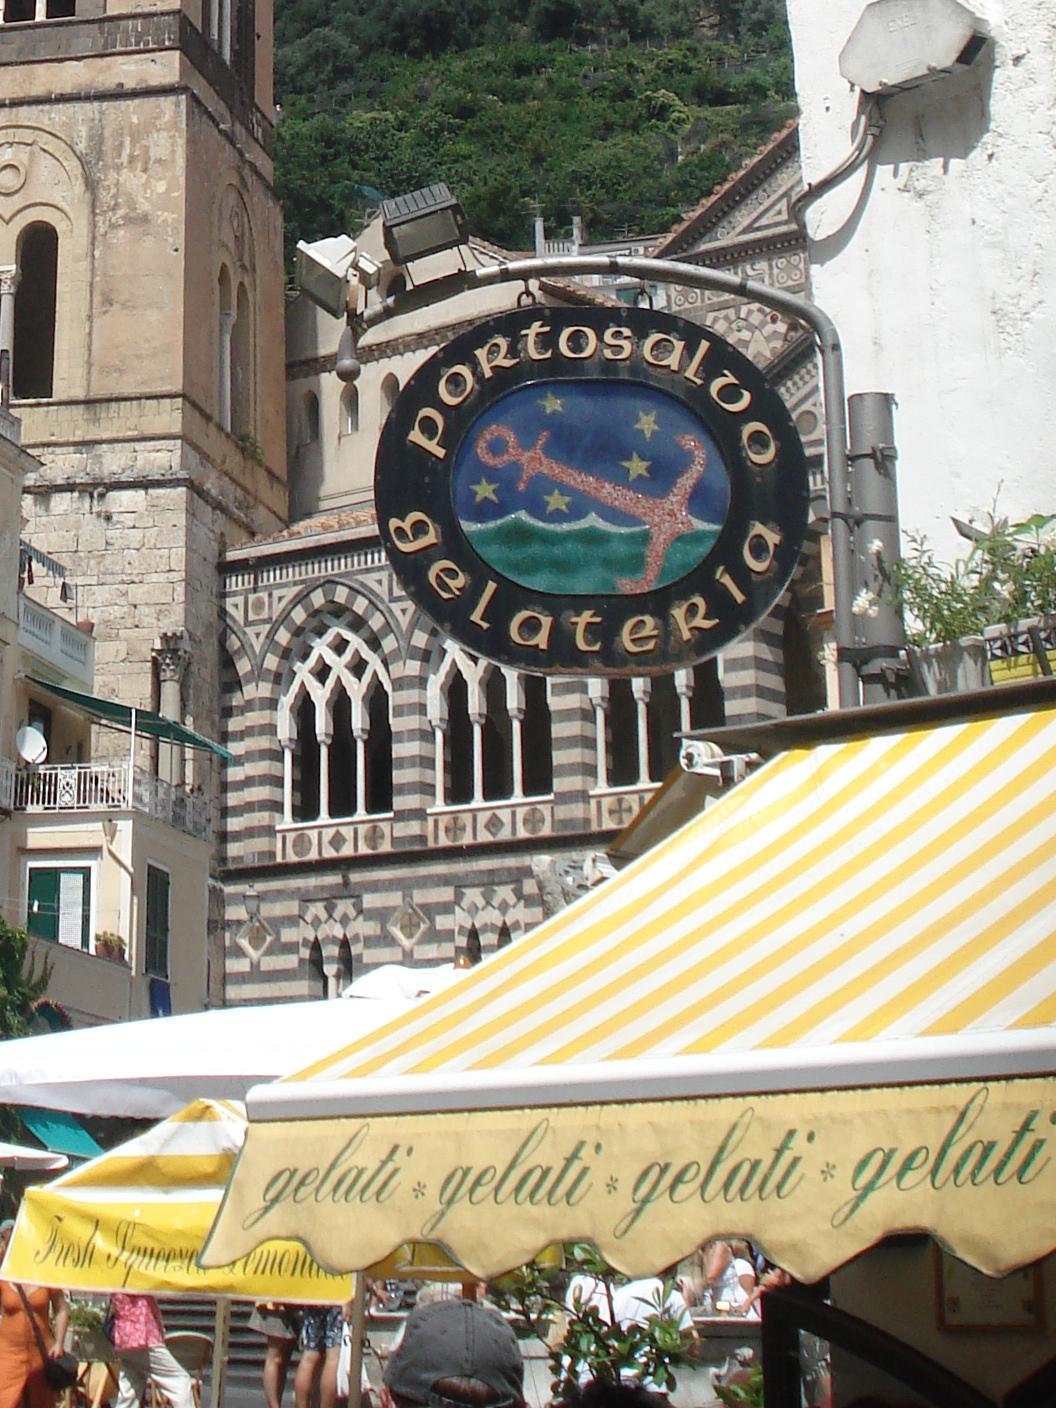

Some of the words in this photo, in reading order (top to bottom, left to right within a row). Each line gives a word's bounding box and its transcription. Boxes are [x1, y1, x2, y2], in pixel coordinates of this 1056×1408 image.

[243, 1122, 414, 1230] gelati
[420, 1118, 603, 1237] gelati
[613, 1106, 816, 1239] gelati
[830, 1086, 1056, 1229] gelati
[33, 1214, 100, 1270] Fresh
